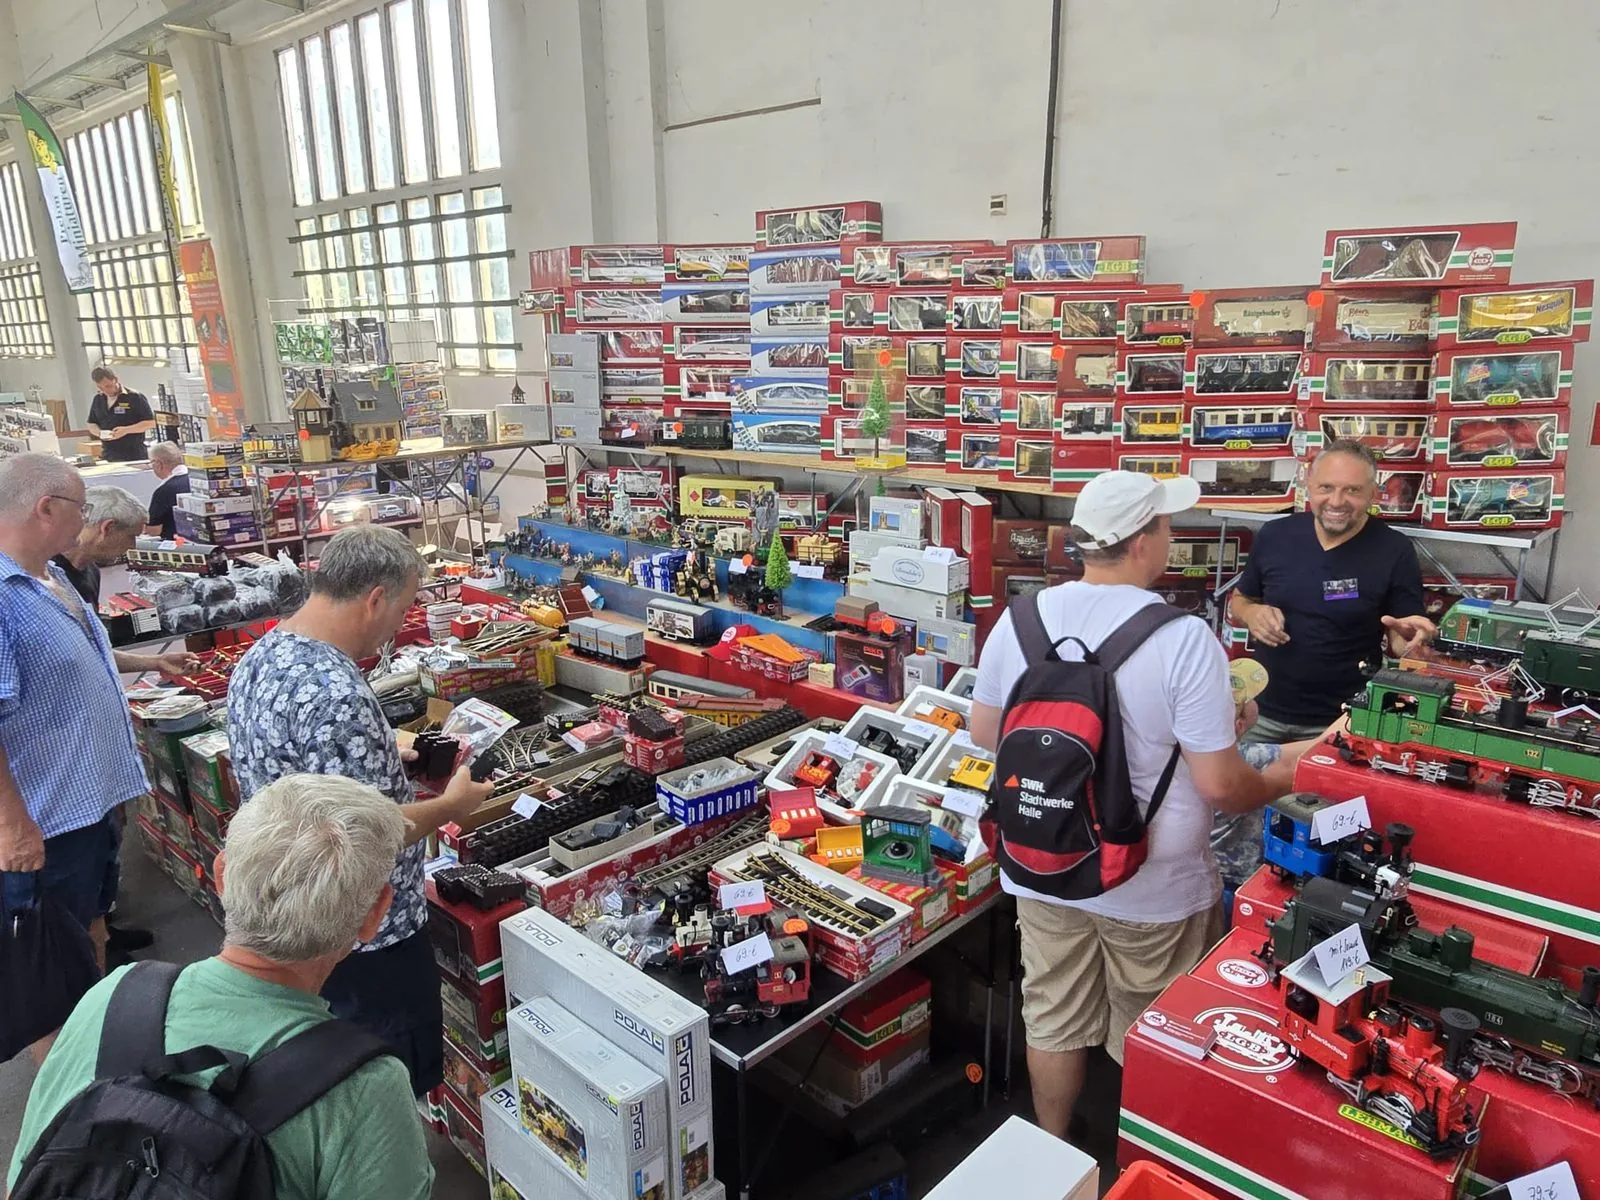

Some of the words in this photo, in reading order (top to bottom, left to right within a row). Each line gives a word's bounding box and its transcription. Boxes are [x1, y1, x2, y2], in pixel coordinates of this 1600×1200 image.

[58, 176, 89, 259] Miniaturen
[1104, 260, 1131, 272] LGB
[1491, 395, 1516, 404] LGB
[1486, 516, 1509, 525] LGB
[1020, 777, 1046, 793] SWH.
[1019, 791, 1075, 809] Stadtwerke
[1018, 804, 1042, 819] Halle
[526, 1016, 551, 1035] POLA
[615, 1008, 651, 1041] POLA
[1294, 1019, 1299, 1029] 1
[1225, 1032, 1262, 1054] LGB
[679, 1052, 692, 1106] POLA
[632, 1113, 643, 1151] POLA
